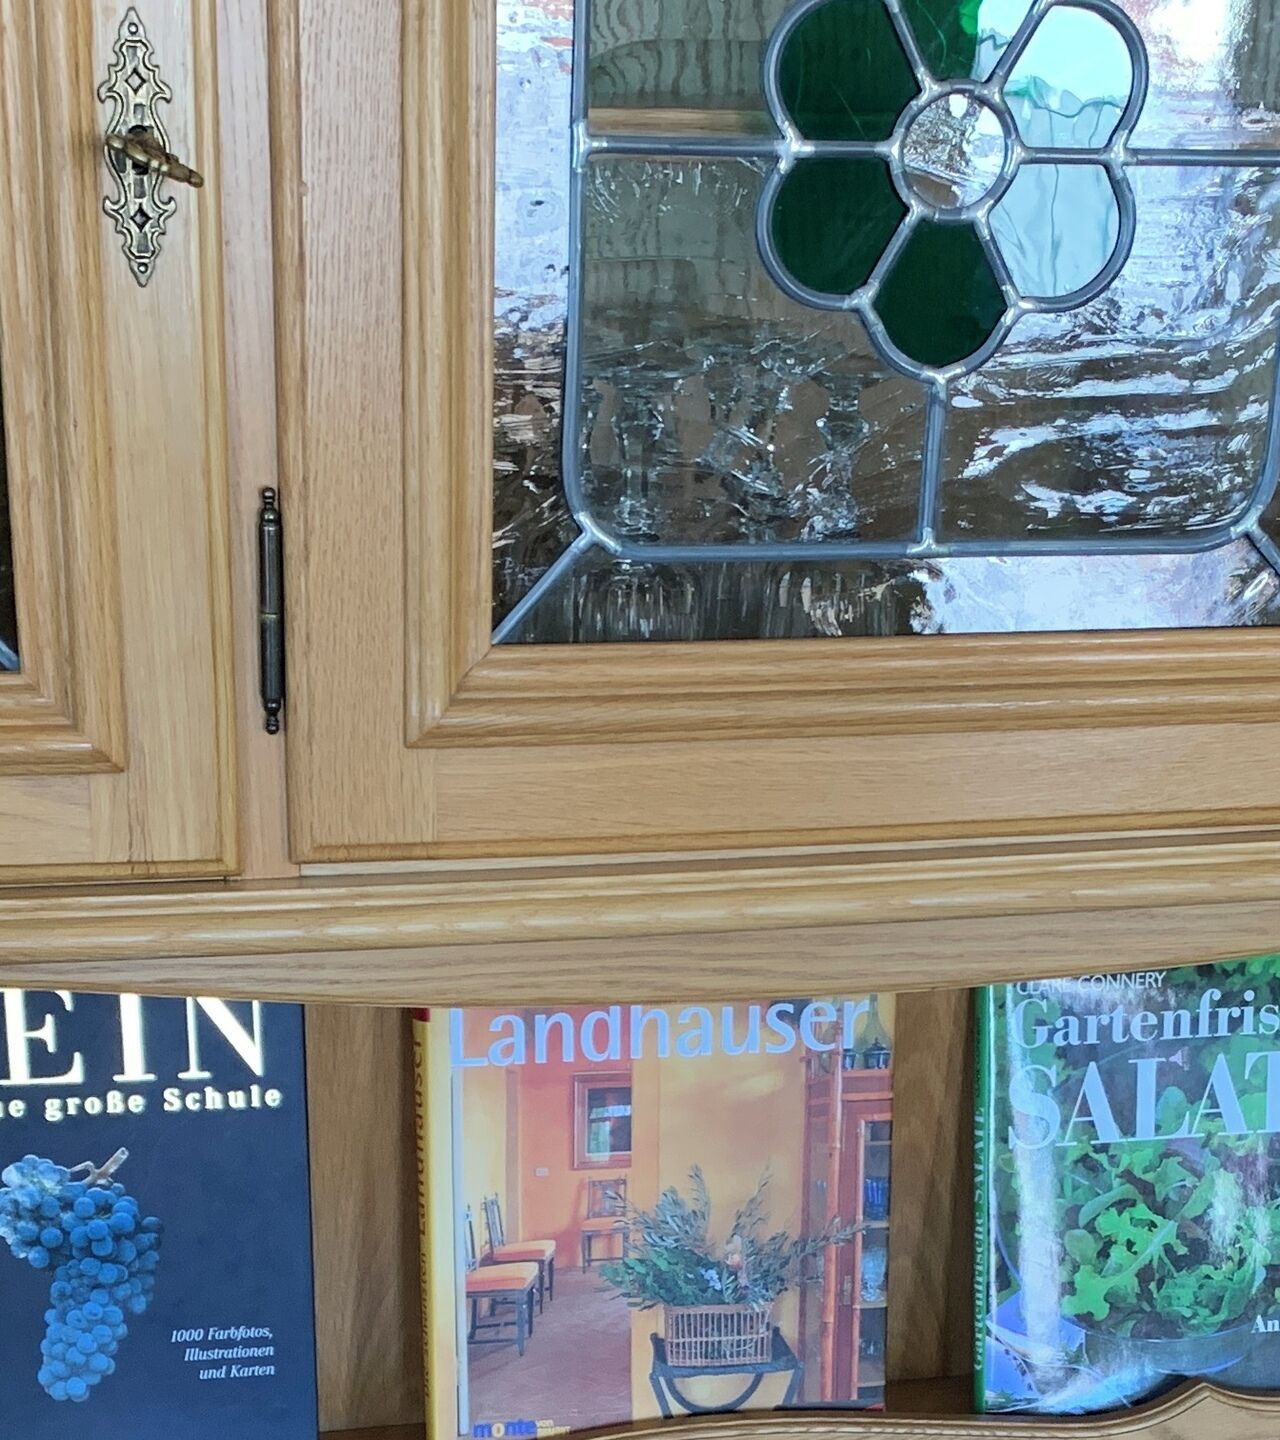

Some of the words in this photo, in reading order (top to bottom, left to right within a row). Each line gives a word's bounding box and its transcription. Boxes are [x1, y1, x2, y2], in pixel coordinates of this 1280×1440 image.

[1078, 970, 1167, 992] CONNERY
[44, 1090, 145, 1123] große
[163, 1082, 282, 1113] Schule
[974, 1106, 987, 1204] SALATE
[171, 1328, 204, 1343] 1000
[208, 1325, 273, 1341] Farbfotos,
[184, 1344, 275, 1362] Illustrationen
[199, 1366, 226, 1380] und
[230, 1363, 276, 1378] Karten
